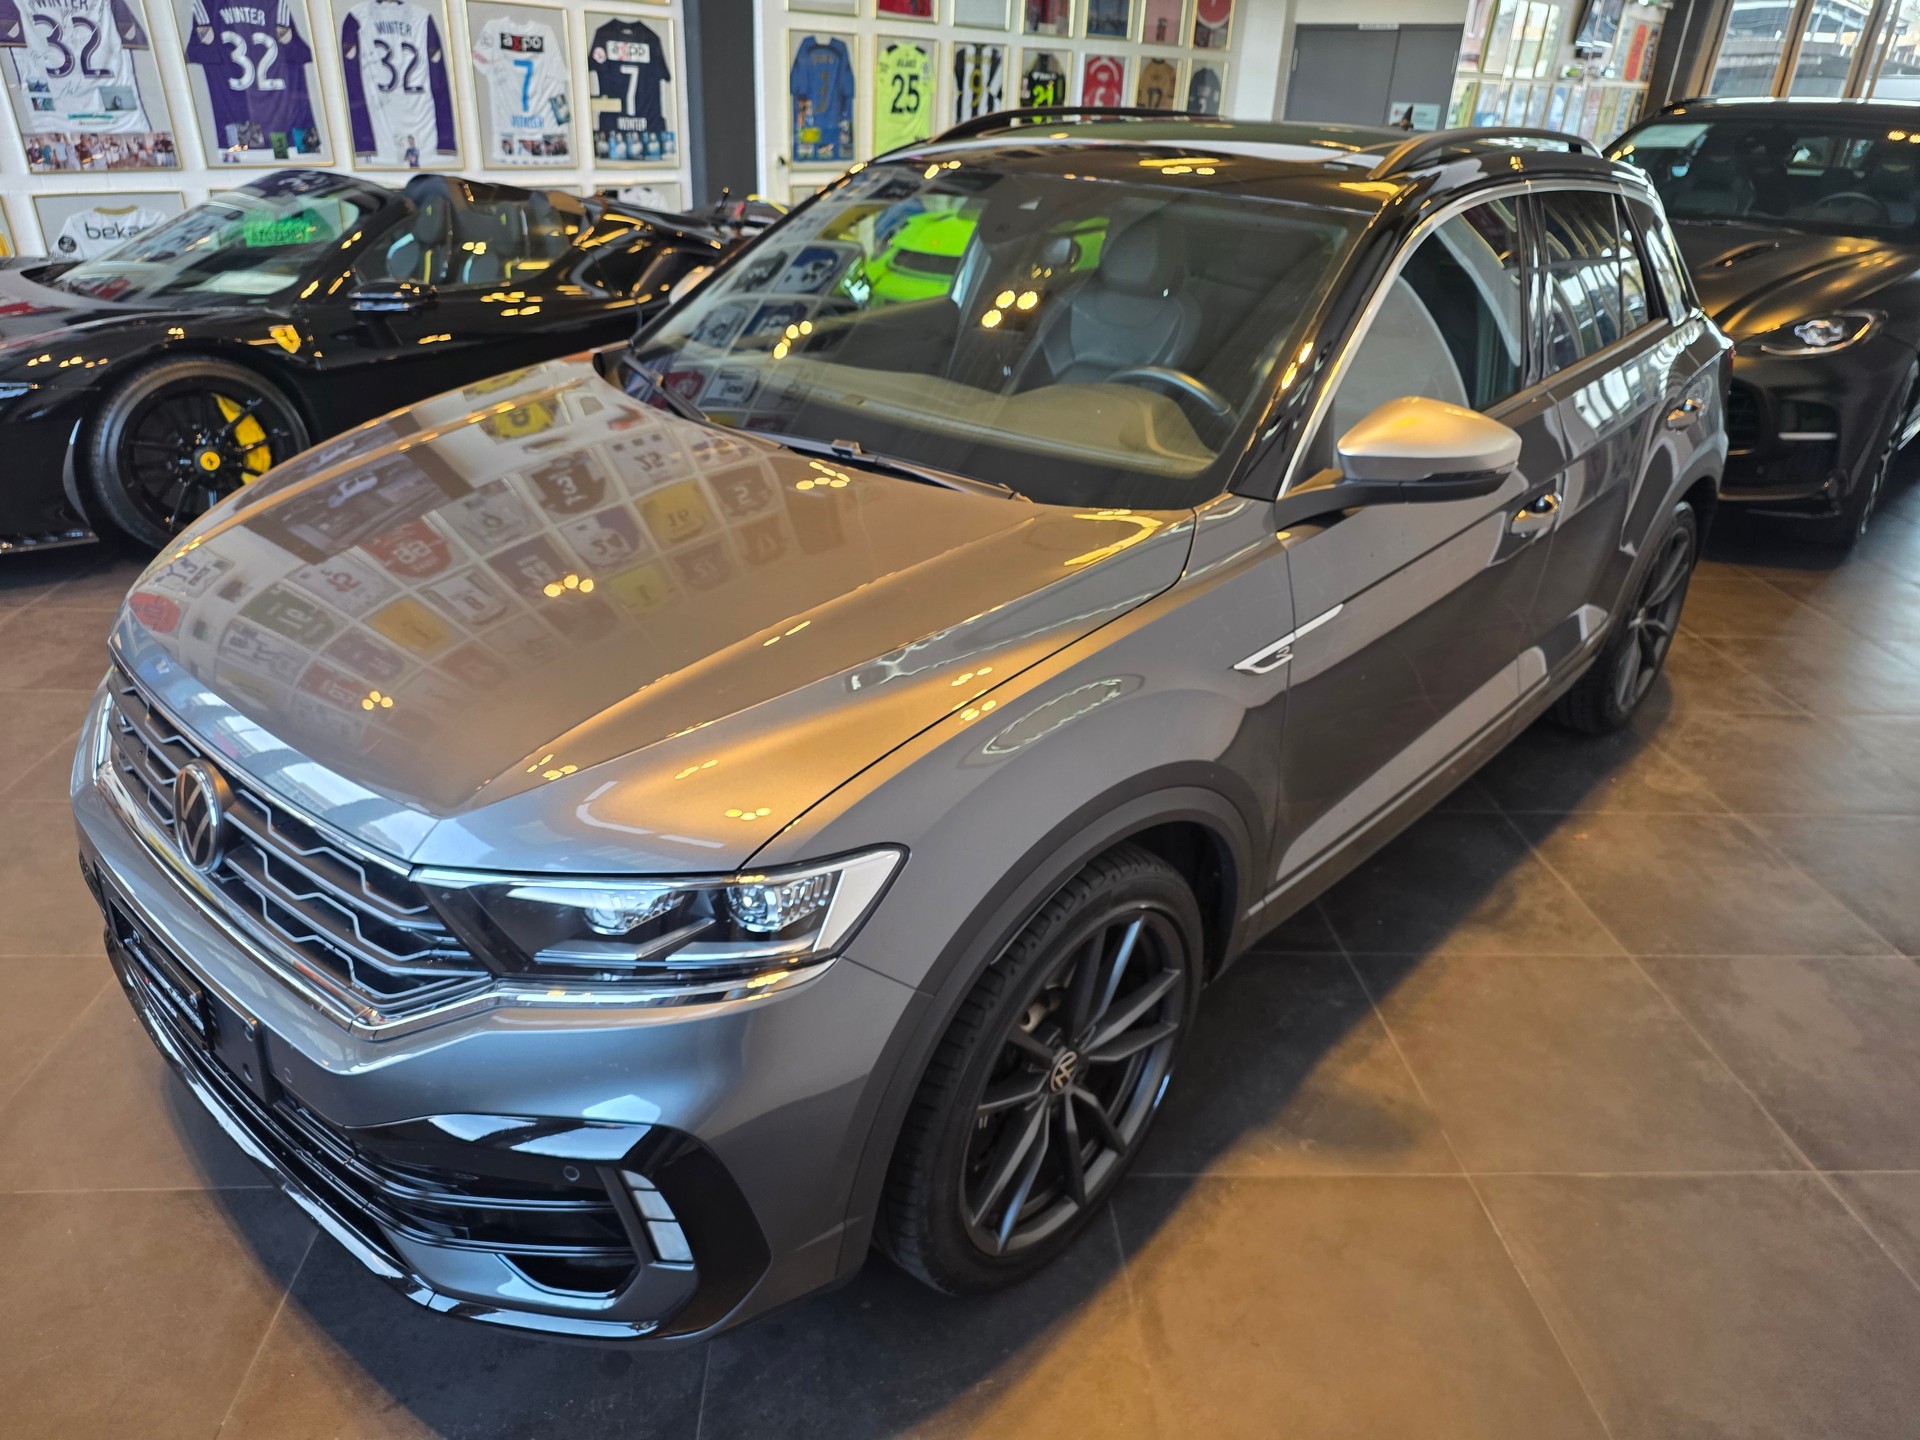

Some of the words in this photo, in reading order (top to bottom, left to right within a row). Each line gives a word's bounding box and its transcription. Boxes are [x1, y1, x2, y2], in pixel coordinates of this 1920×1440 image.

[219, 6, 266, 27] WINTER
[375, 20, 412, 37] WINTER
[33, 14, 115, 78] 32
[221, 30, 286, 91] 32
[374, 39, 425, 94] 32
[514, 59, 533, 112] 7
[620, 65, 639, 116] 7
[891, 74, 920, 114] 25
[617, 117, 647, 131] WINTER
